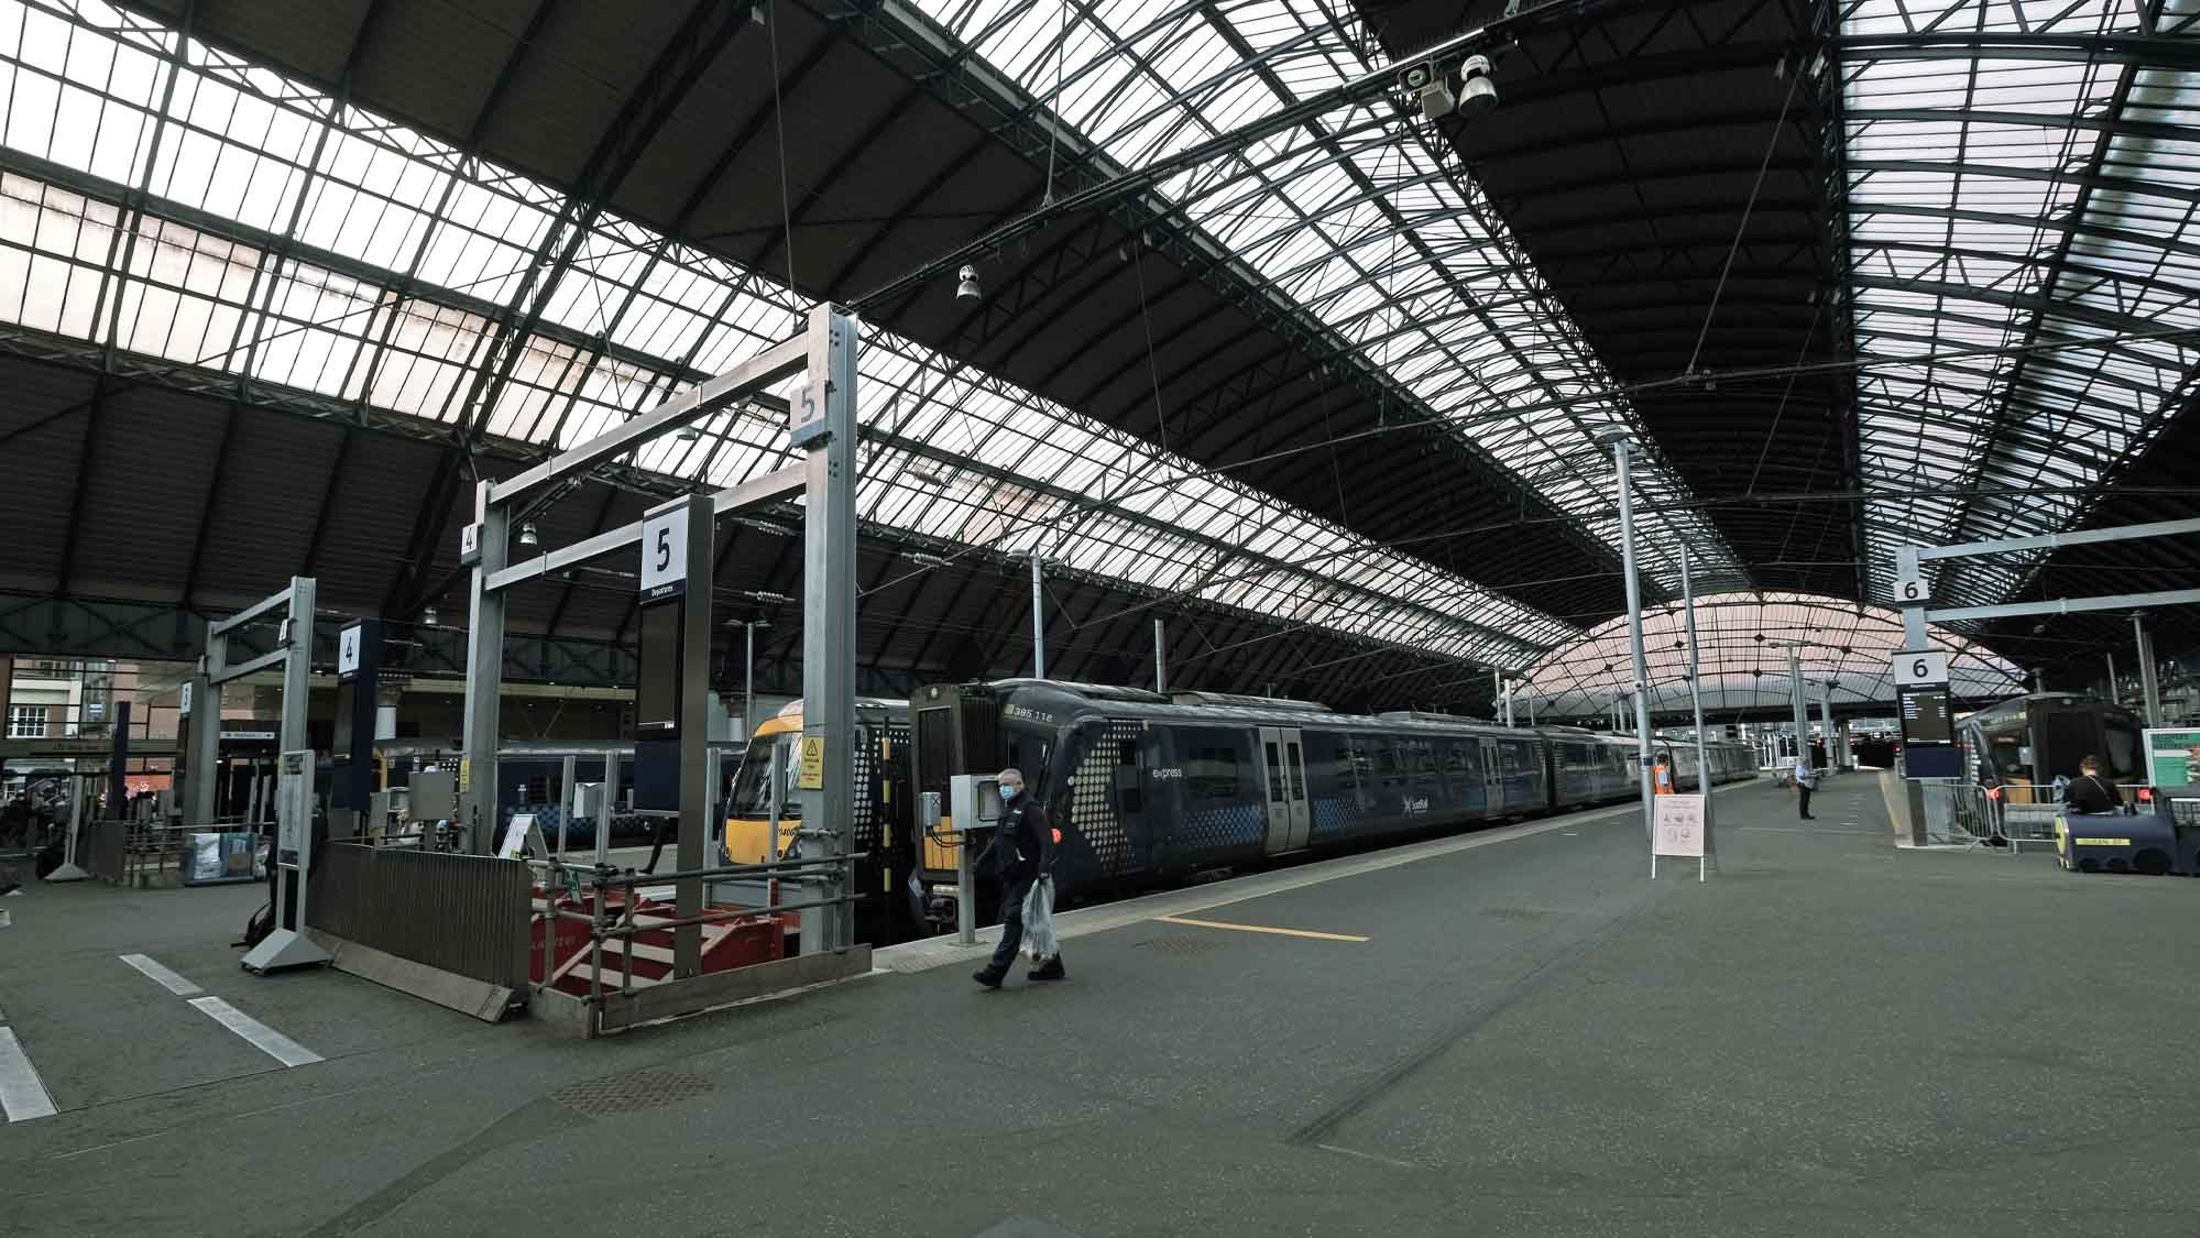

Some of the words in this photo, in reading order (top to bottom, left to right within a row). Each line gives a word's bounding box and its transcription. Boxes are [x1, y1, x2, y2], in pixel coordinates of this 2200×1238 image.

[801, 384, 815, 423] 5
[466, 527, 472, 550] 4
[657, 527, 670, 572] 5
[1904, 582, 1919, 599] 6
[346, 636, 353, 664] 4
[1913, 659, 1928, 678] 6
[1152, 768, 1182, 780] express
